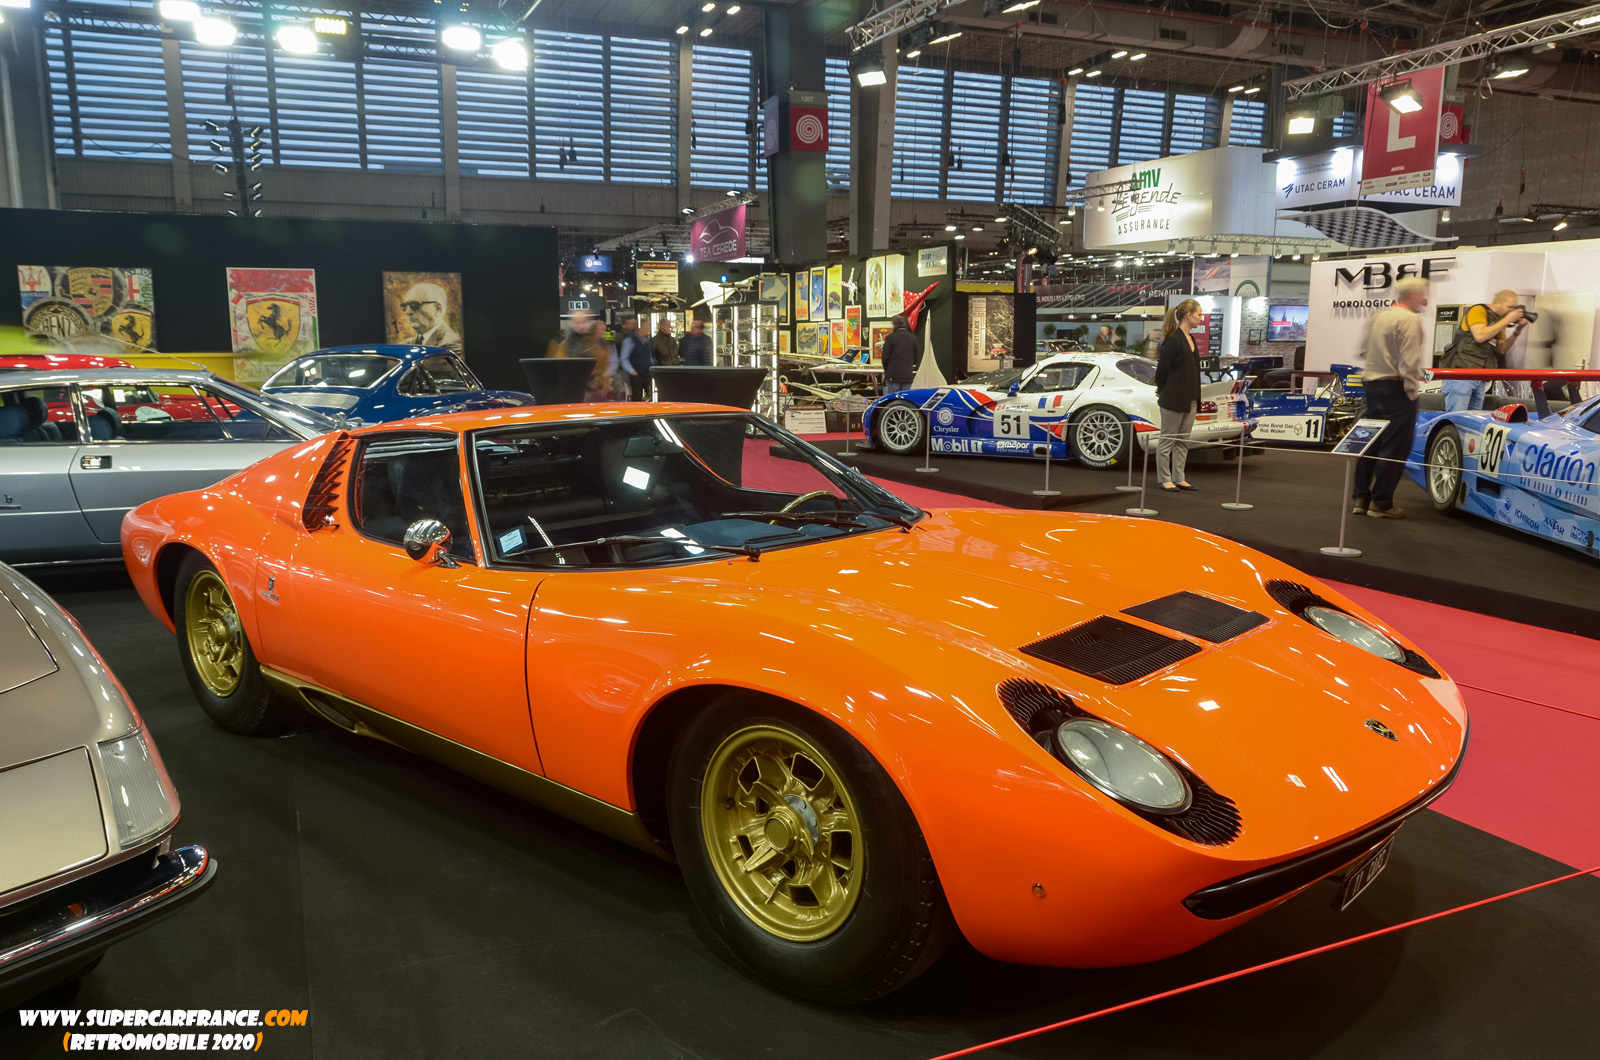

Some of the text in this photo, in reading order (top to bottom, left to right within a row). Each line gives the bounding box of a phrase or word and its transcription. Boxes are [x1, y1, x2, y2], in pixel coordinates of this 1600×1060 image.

[1295, 178, 1346, 194] UTAC CERAM
[1414, 185, 1456, 199] CERAM
[1118, 218, 1171, 236] ASSURANCE
[700, 239, 737, 257] TEA CEREDE
[1148, 288, 1183, 298] RENAULT
[1333, 299, 1397, 309] HOROLOGICA
[933, 425, 960, 434] Chrysler
[1001, 414, 1022, 436] 51
[1305, 419, 1320, 439] 11
[931, 437, 969, 454] Mobil
[1481, 426, 1504, 473] 30
[1514, 508, 1540, 532] ICHIKOH
[1543, 516, 1565, 536] ANTAR
